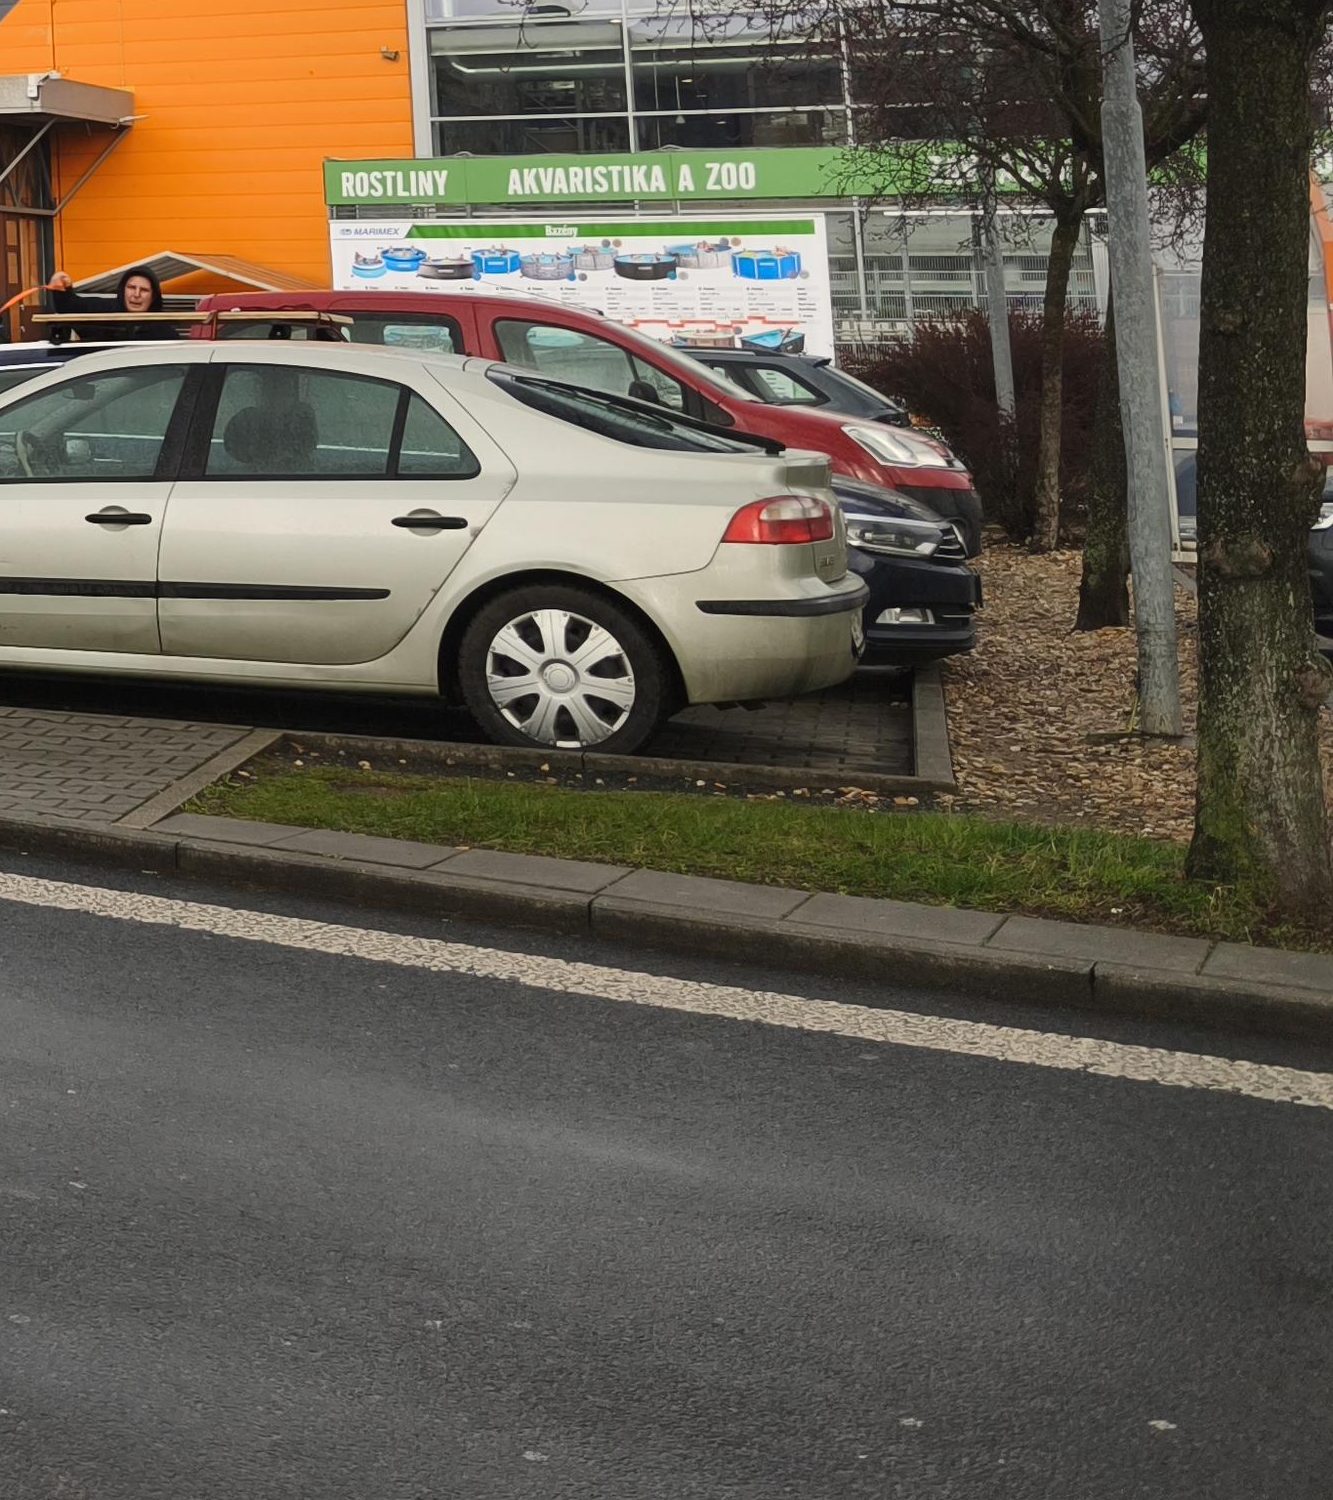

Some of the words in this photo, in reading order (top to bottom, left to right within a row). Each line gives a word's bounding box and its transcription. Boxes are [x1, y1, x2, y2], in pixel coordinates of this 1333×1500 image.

[341, 170, 448, 198] ROSTLINY
[507, 164, 666, 195] AKVARISTIKA
[678, 164, 695, 192] A
[706, 161, 757, 191] ZOO
[354, 228, 400, 236] MARIMEX
